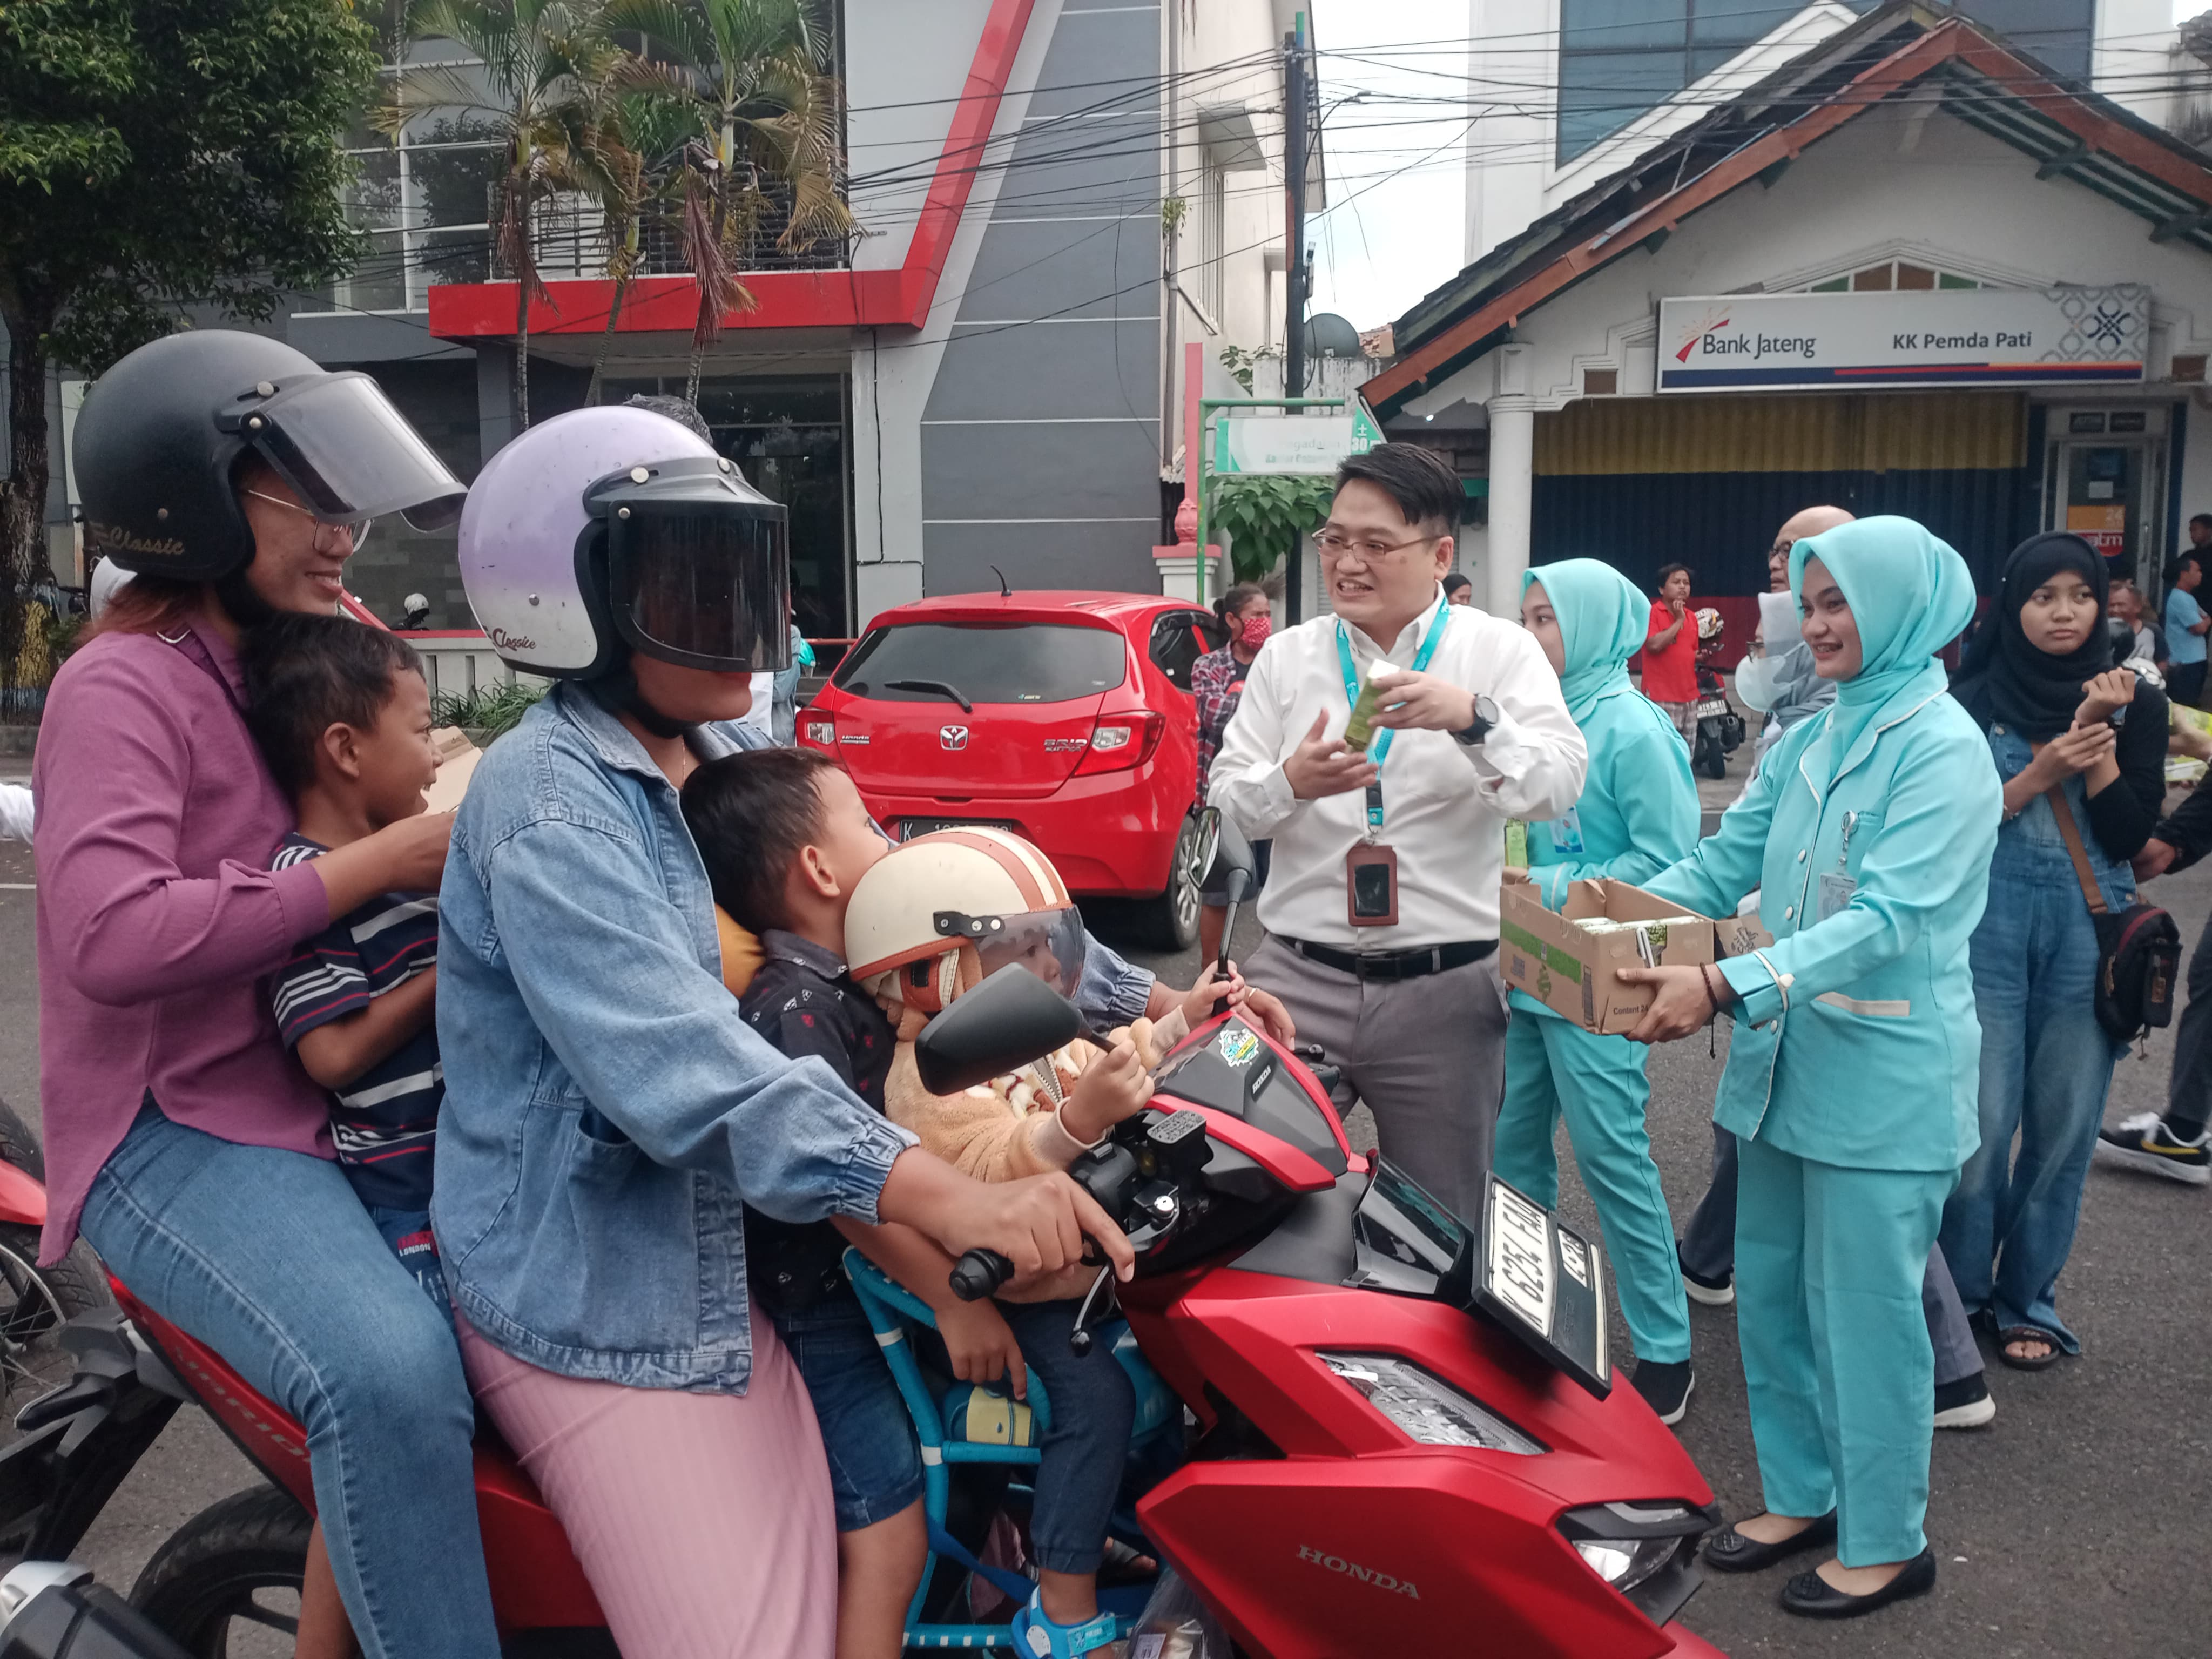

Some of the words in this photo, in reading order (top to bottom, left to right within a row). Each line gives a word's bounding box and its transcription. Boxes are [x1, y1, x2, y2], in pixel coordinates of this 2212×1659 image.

[1703, 333, 1751, 354] Bank
[1754, 333, 1817, 359] Jateng
[1893, 334, 1918, 349] KK
[1924, 332, 1989, 348] Pemda
[1996, 331, 2032, 347] Pati
[1352, 437, 1368, 451] 30
[1613, 1006, 1640, 1015] Content
[1252, 1065, 1271, 1094] HONDA
[1502, 1192, 1542, 1245] FAA
[399, 1243, 431, 1257] LONDON
[1502, 1231, 1544, 1303] 6254
[1502, 1289, 1543, 1330] K
[1297, 1545, 1420, 1600] HONDA
